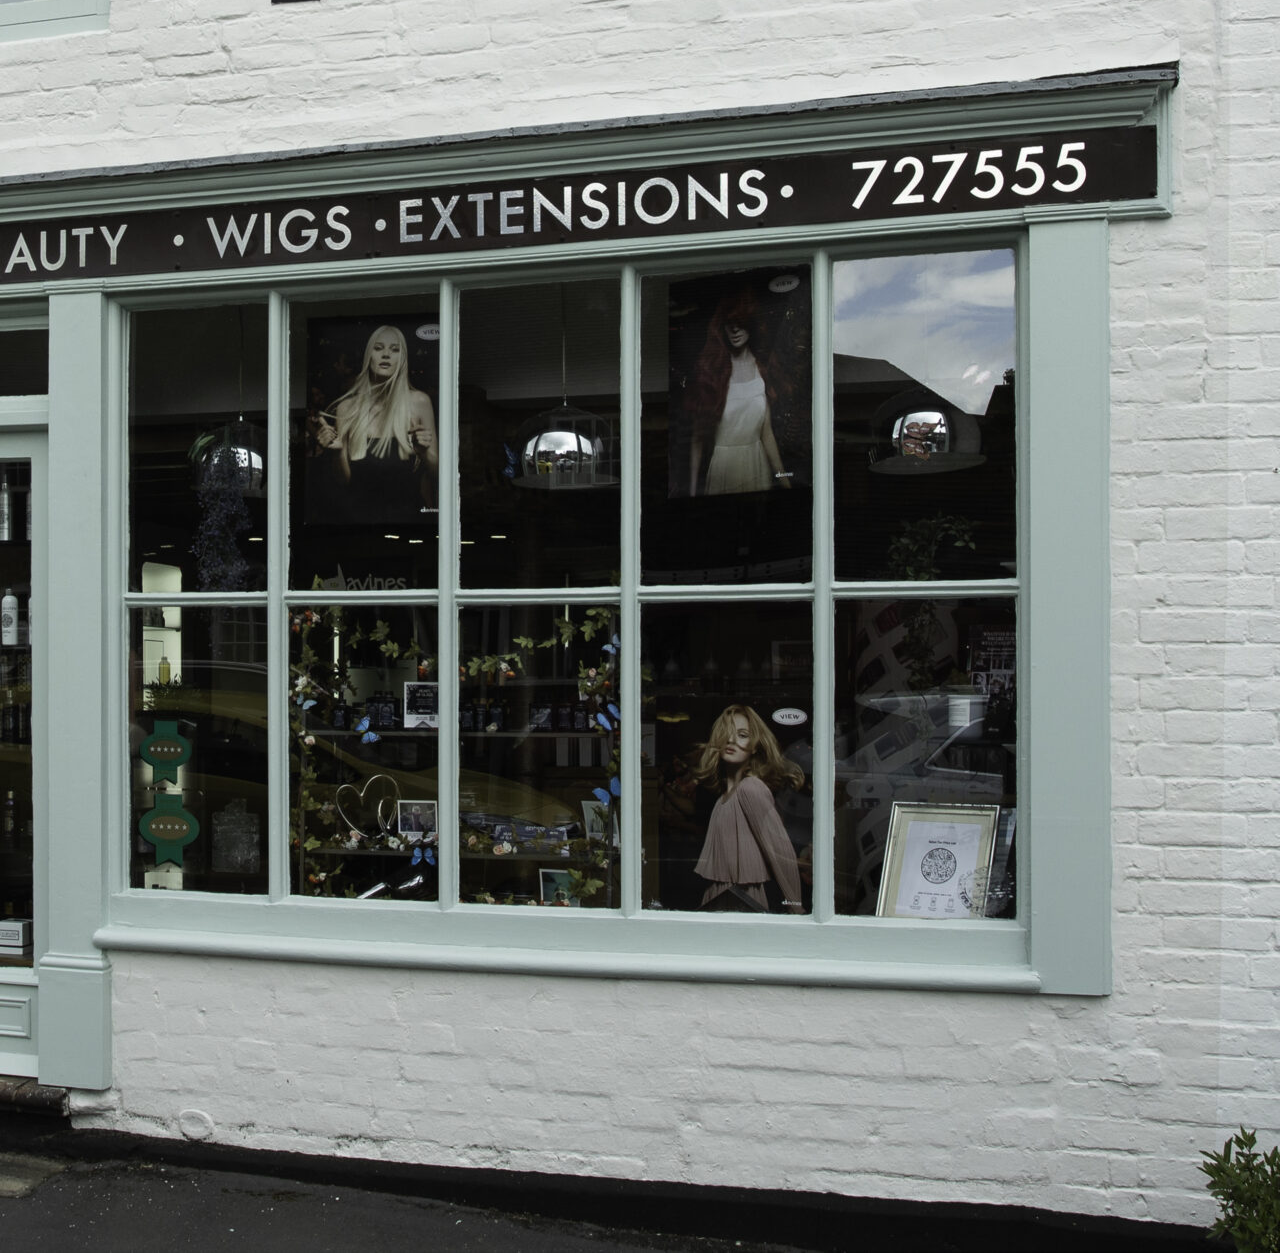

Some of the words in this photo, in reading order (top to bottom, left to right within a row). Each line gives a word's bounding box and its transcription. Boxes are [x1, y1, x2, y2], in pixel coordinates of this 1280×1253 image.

[206, 205, 352, 259] WIGS
[399, 169, 768, 243] EXTENSIONS
[852, 142, 1087, 210] 727555
